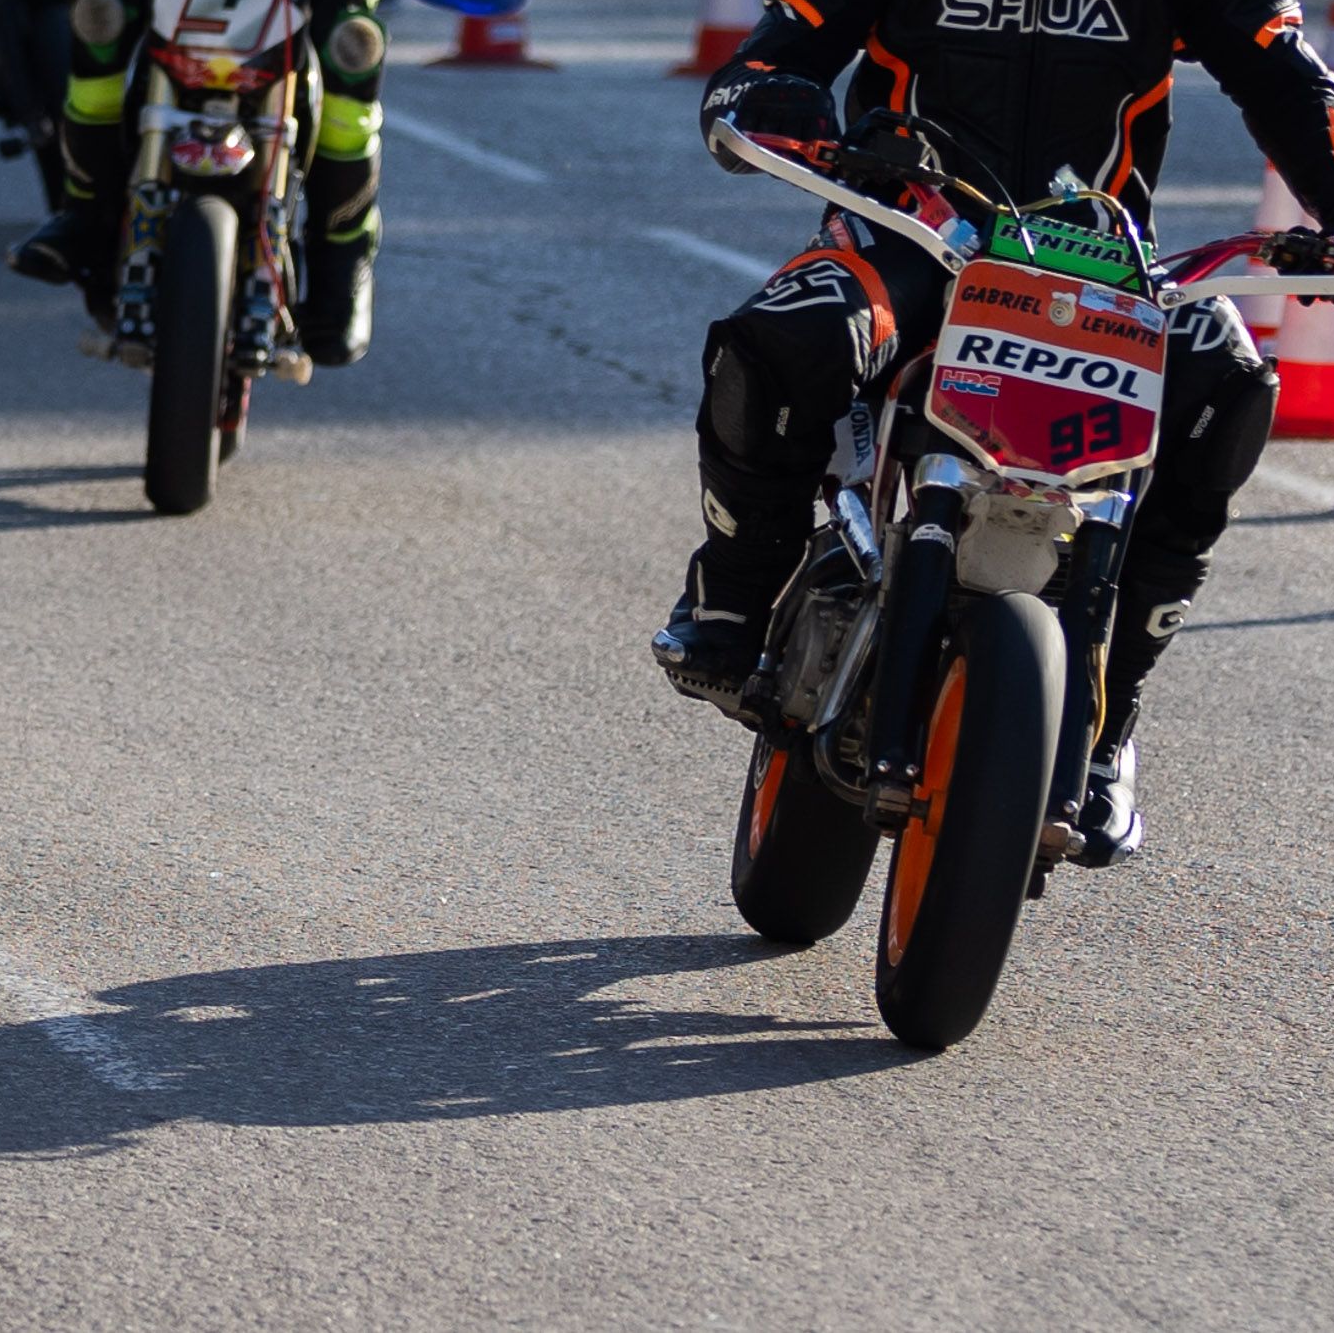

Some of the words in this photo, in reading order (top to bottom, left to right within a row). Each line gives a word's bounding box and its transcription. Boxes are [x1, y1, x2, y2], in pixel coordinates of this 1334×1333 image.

[961, 284, 1043, 316] GABRIEL
[1080, 315, 1161, 348] LEVANTE
[940, 368, 1003, 397] HRC
[956, 334, 1139, 399] REPSOL
[1049, 400, 1122, 466] 93
